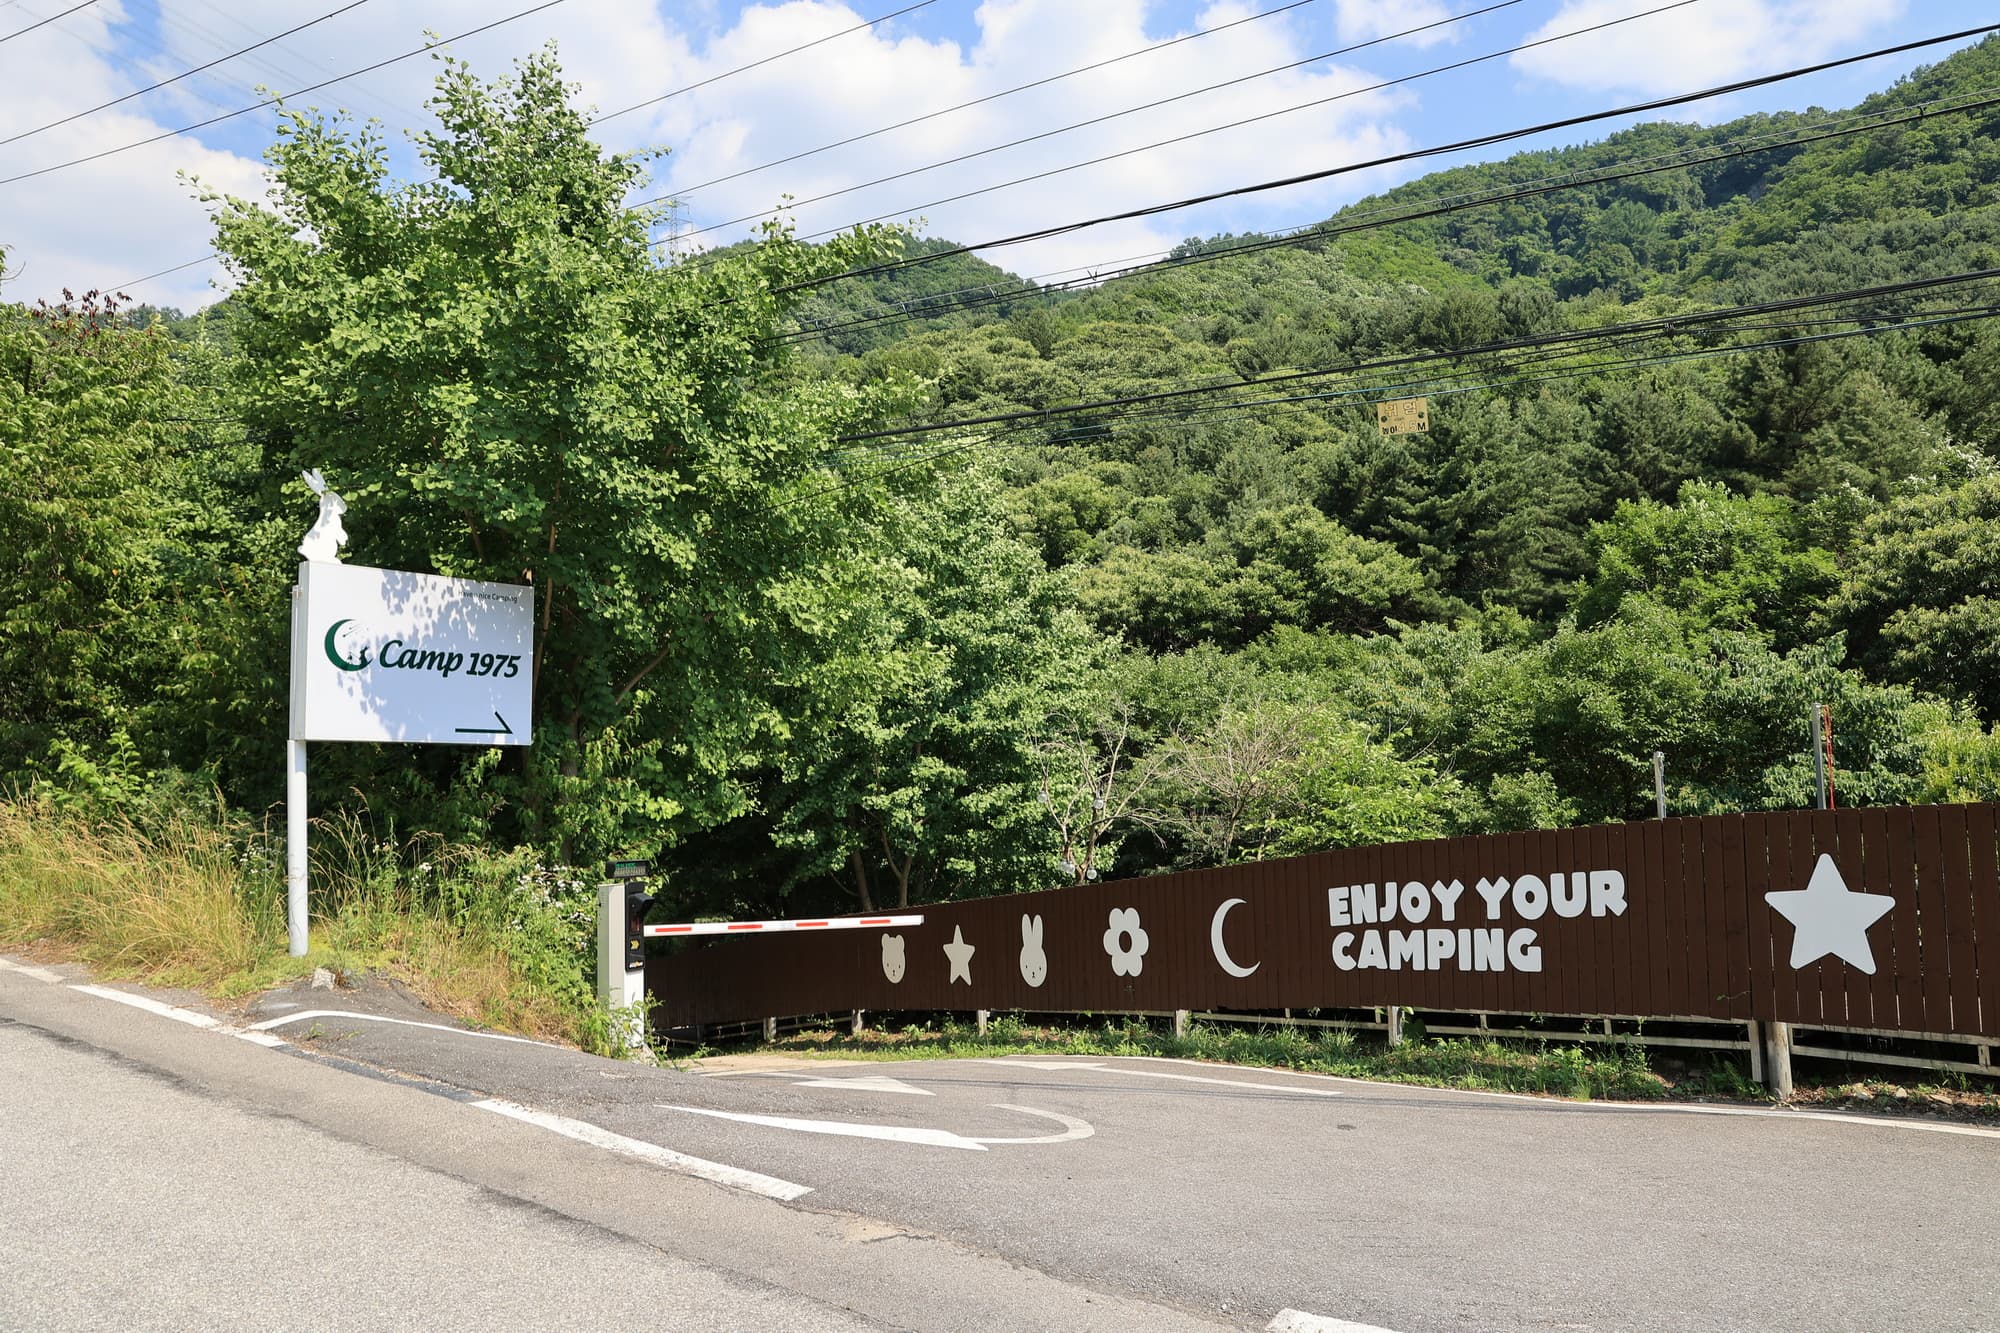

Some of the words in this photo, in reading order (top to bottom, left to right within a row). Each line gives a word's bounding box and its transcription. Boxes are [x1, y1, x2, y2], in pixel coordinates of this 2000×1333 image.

[478, 592, 491, 600] nice
[379, 639, 464, 678] Camp
[465, 652, 521, 678] 1975
[1328, 879, 1464, 927] ENJOY
[1475, 869, 1628, 920] YOUR
[1331, 927, 1542, 972] CAMPING
